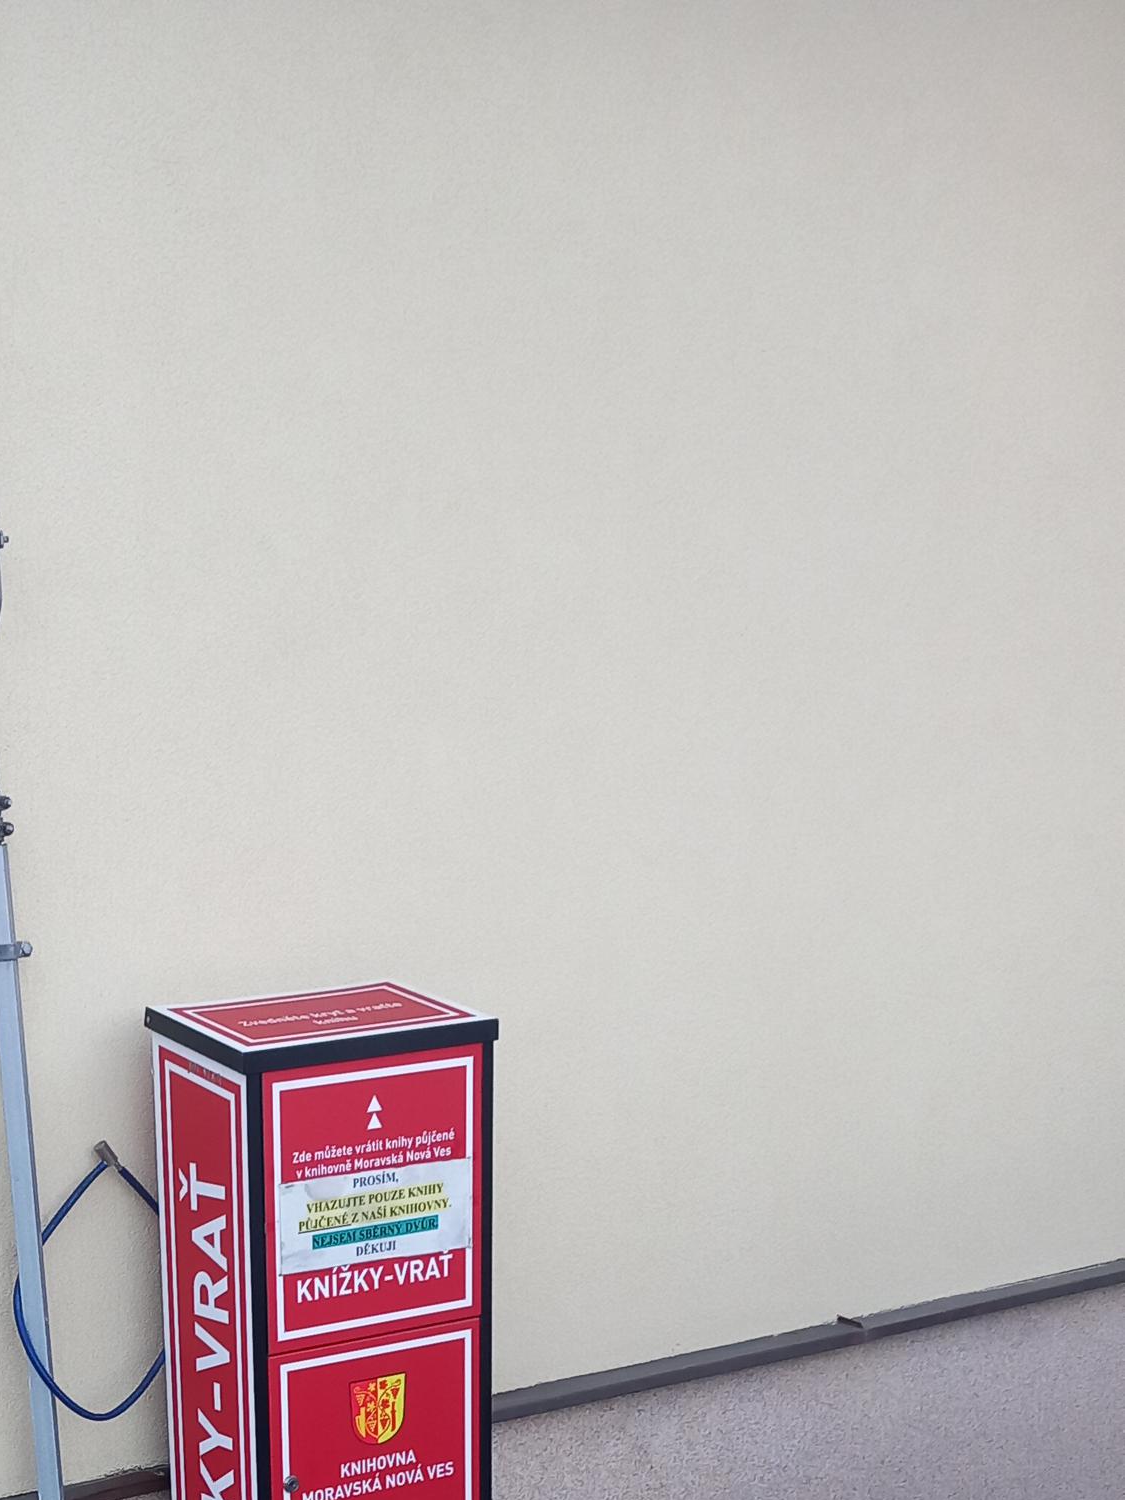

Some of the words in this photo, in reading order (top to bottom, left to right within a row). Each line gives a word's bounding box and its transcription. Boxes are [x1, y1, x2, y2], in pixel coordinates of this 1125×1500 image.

[292, 1151, 312, 1164] Zde
[314, 1145, 353, 1160] můžete
[354, 1139, 383, 1152] vrátit
[385, 1134, 413, 1149] knihy
[415, 1127, 456, 1147] půjčené
[295, 1169, 303, 1180] v
[304, 1160, 352, 1178] knihovně
[354, 1150, 404, 1170] Moravská
[406, 1148, 432, 1162] Nová
[433, 1145, 452, 1157] Ves
[306, 1195, 366, 1214] VHAZUJTE
[368, 1190, 406, 1205] POUZE
[408, 1183, 444, 1198] KNIHY
[298, 1214, 350, 1234] PŮJČENÉ
[350, 1211, 360, 1225] Z
[361, 1206, 388, 1223] NAŠÍ
[312, 1232, 356, 1248] NEJSEM
[355, 1240, 397, 1257] DĚKUJI
[340, 1449, 417, 1478] KNIHOVNA
[385, 1464, 425, 1490] NOVÁ
[426, 1461, 455, 1480] VES
